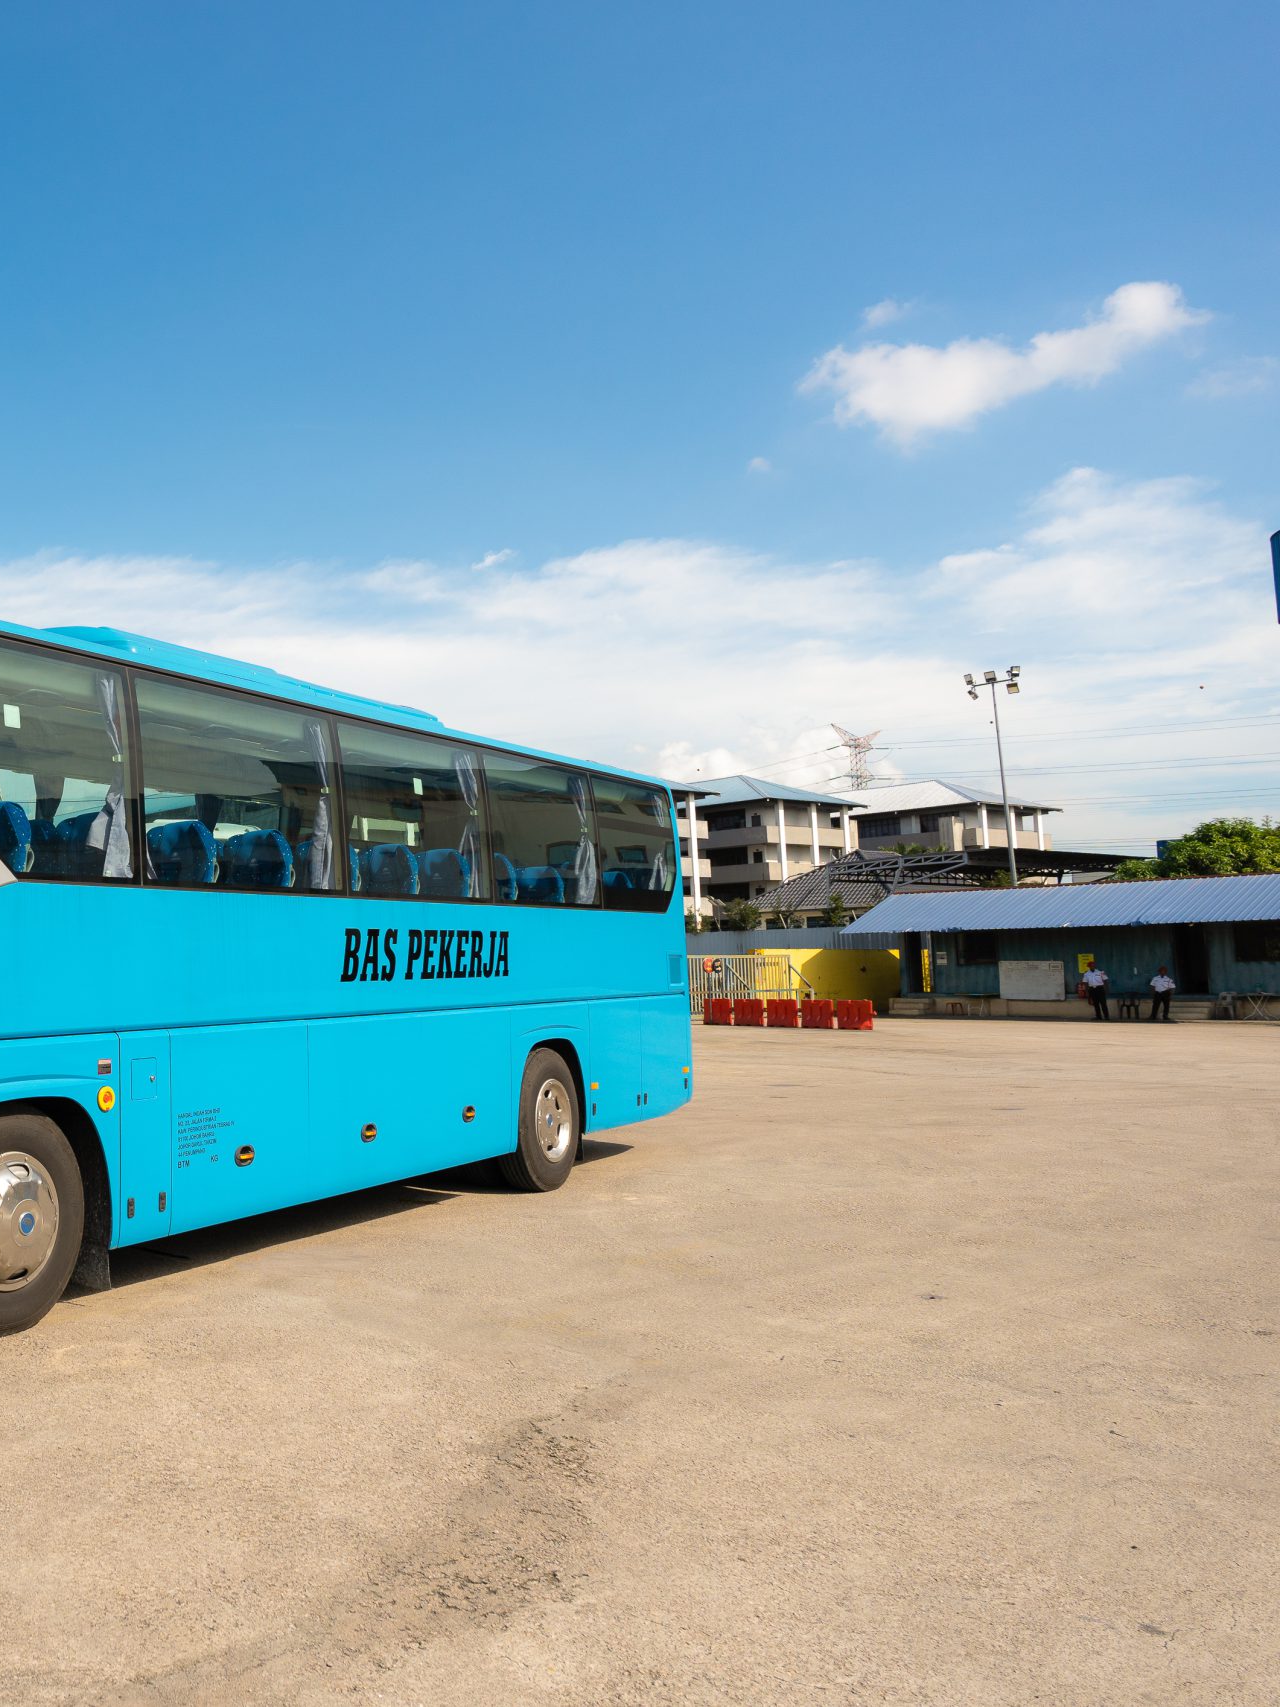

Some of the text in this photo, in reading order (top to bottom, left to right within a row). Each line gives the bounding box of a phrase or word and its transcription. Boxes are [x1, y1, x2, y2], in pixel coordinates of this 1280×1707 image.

[340, 928, 510, 983] BAS PEKERJA
[177, 1154, 219, 1169] BTM KG
